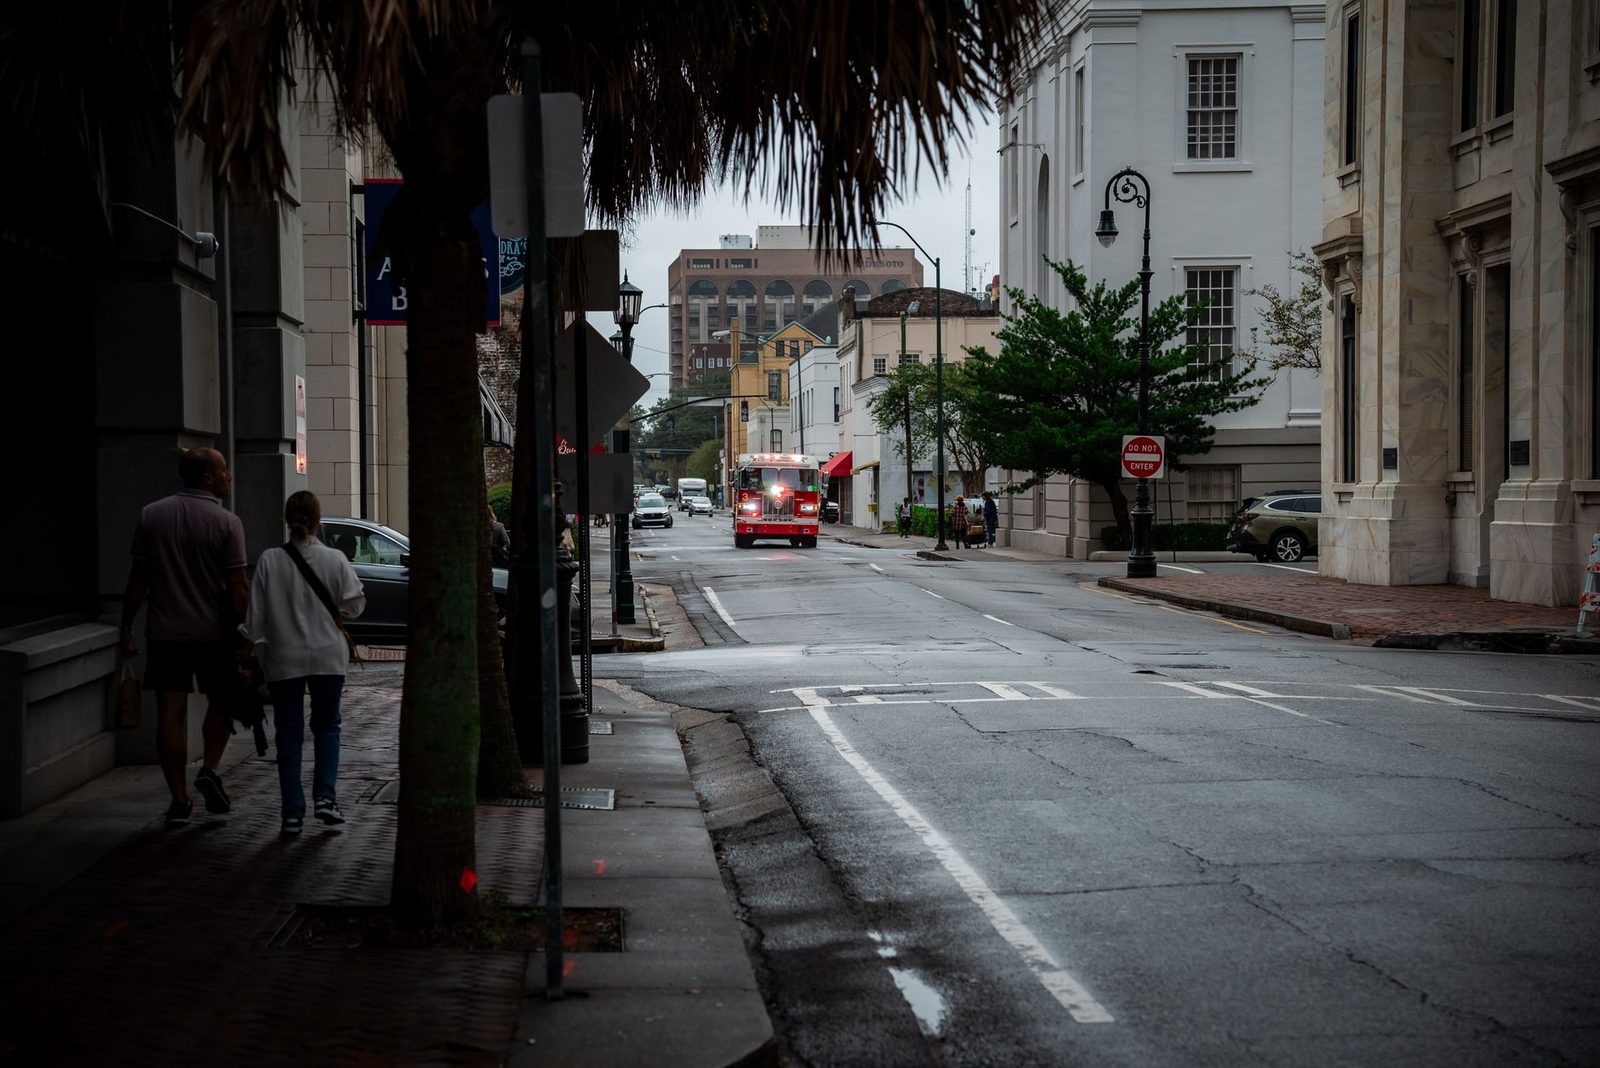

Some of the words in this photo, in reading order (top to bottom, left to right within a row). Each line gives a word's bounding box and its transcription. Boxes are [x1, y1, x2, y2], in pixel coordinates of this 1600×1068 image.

[1128, 444, 1139, 452] DO
[1142, 444, 1158, 452] NOT
[1130, 462, 1154, 470] ENTER
[741, 492, 749, 501] 3
